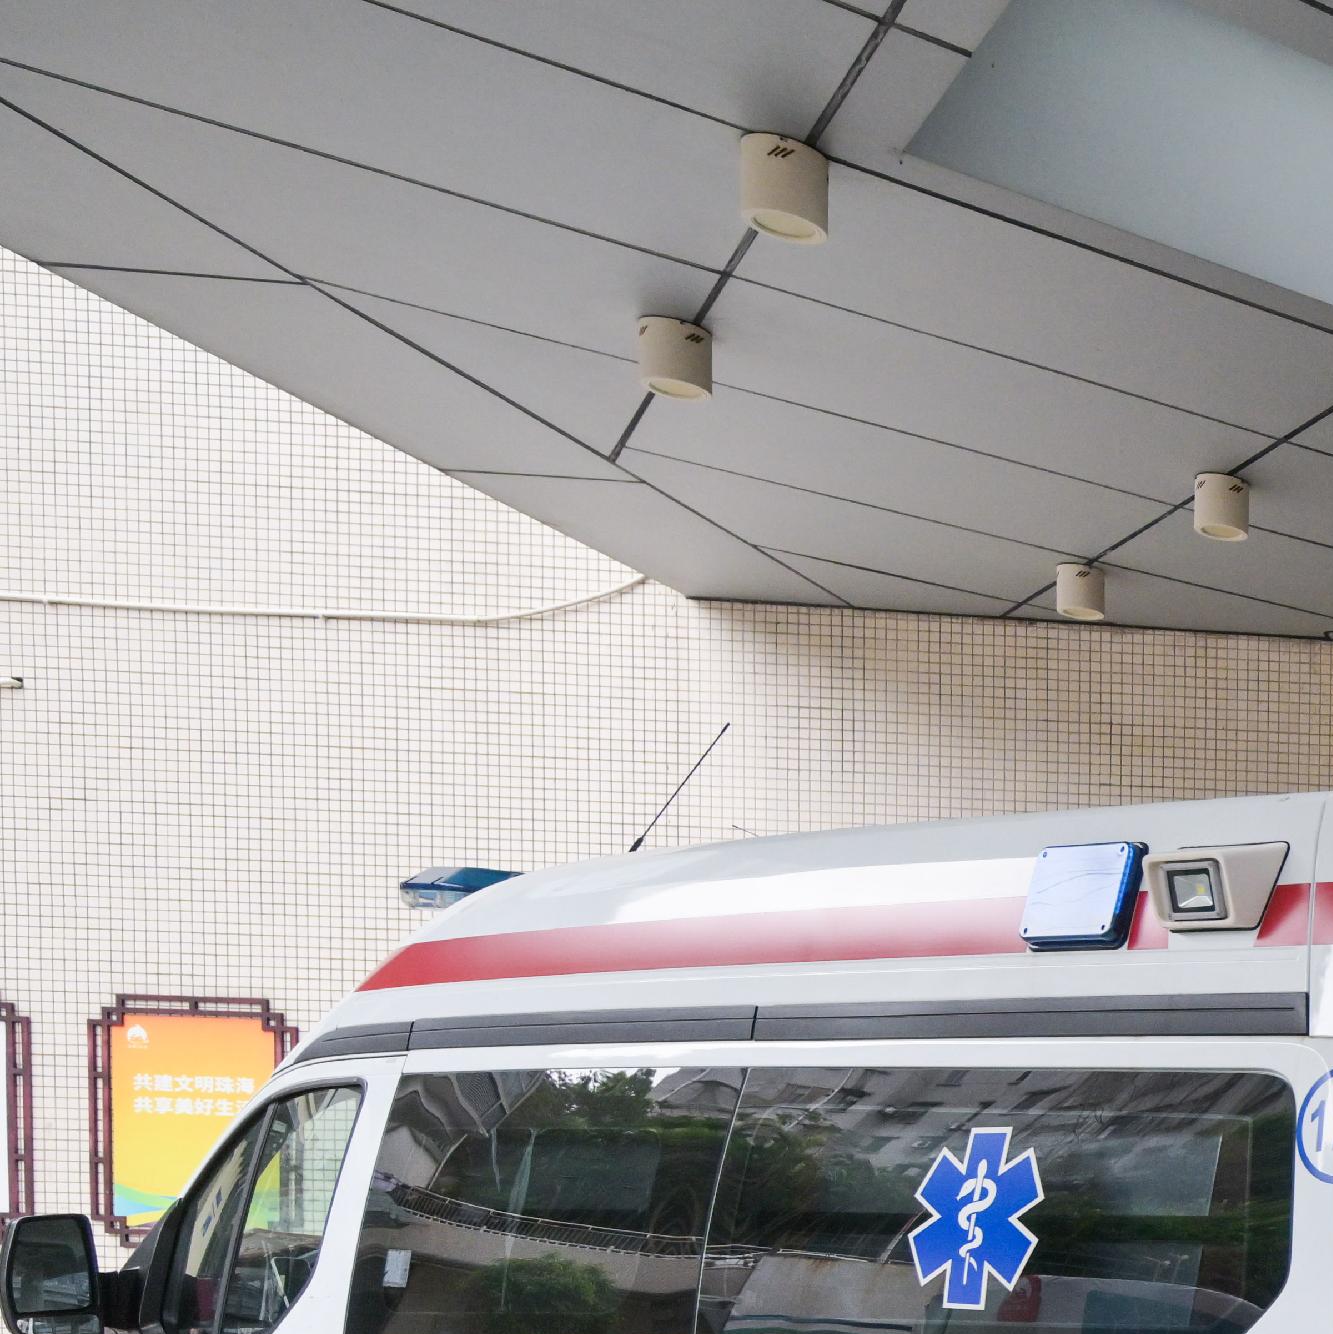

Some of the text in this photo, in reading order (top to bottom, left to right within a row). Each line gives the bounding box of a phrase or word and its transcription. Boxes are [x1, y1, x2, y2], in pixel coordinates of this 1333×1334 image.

[133, 1073, 256, 1094] 共建文明珠海
